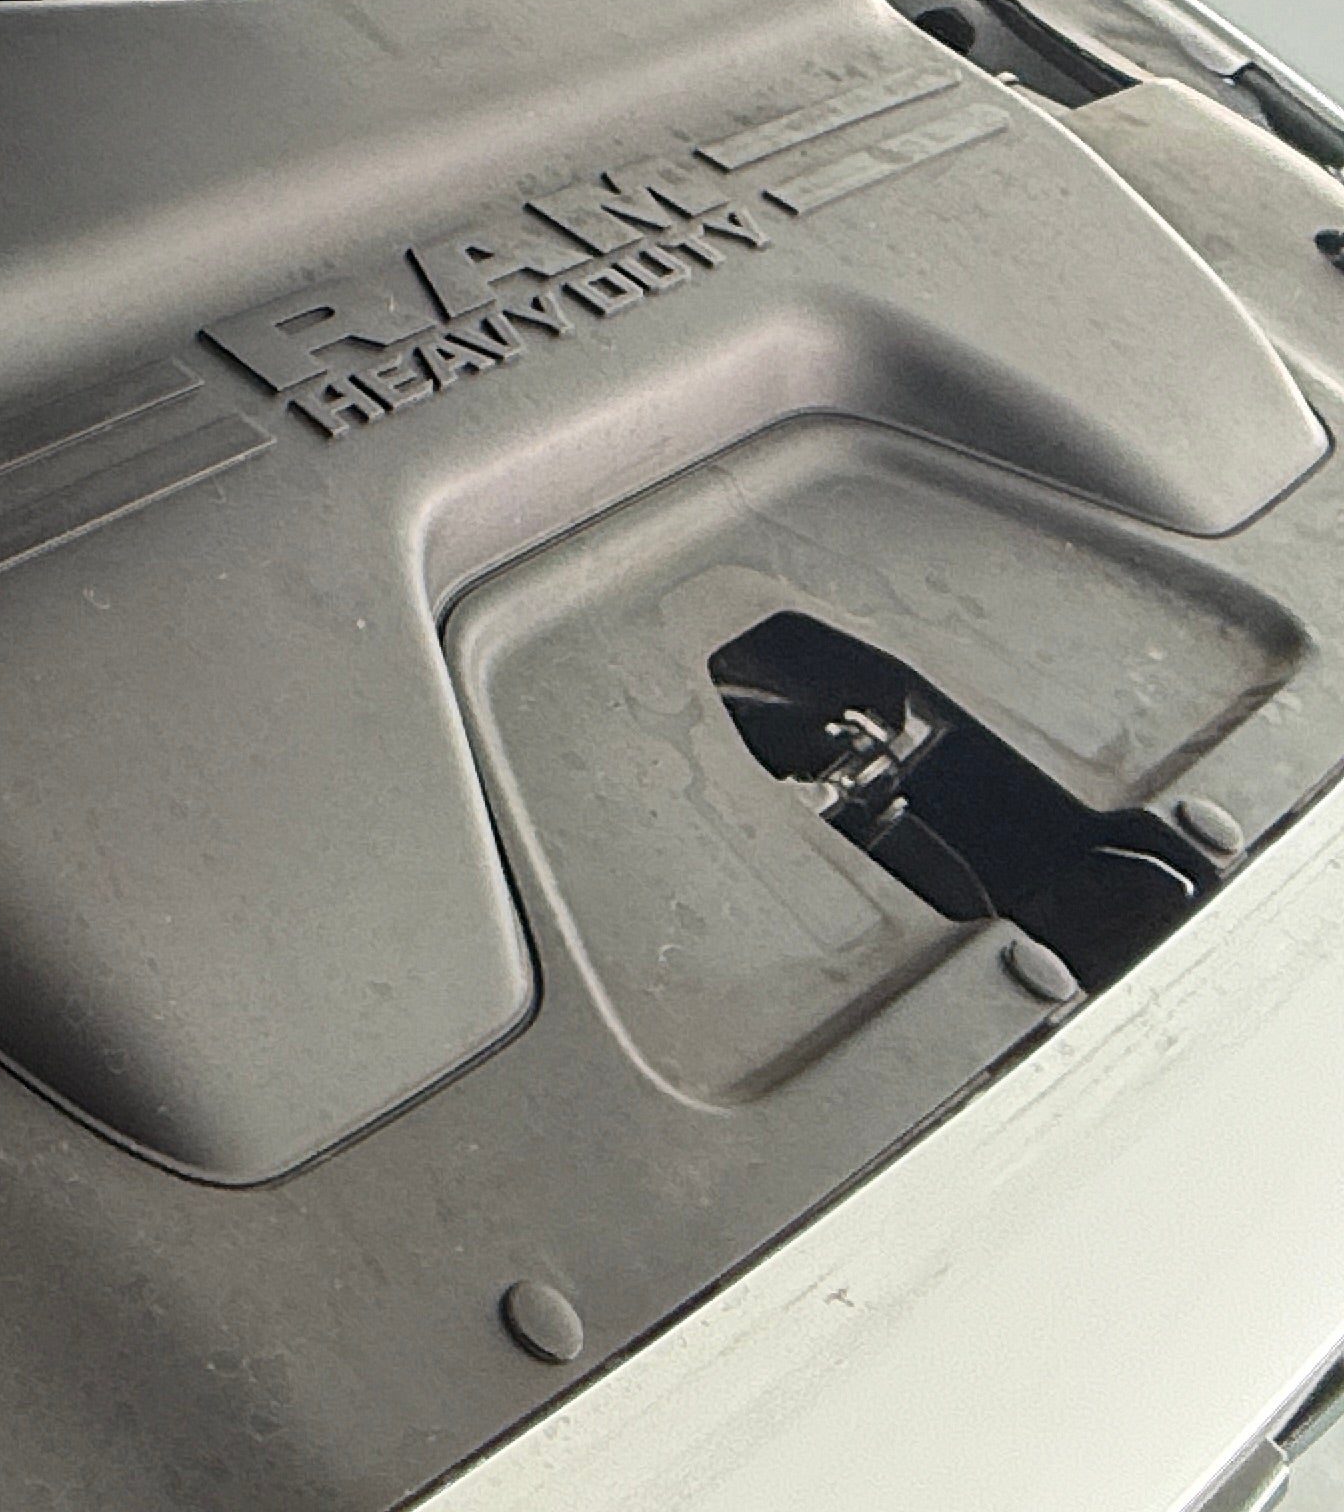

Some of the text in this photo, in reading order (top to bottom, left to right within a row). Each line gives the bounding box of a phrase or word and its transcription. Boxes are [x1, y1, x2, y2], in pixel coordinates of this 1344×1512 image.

[198, 156, 730, 392] RAM
[288, 206, 770, 438] HEAVY DUTY
